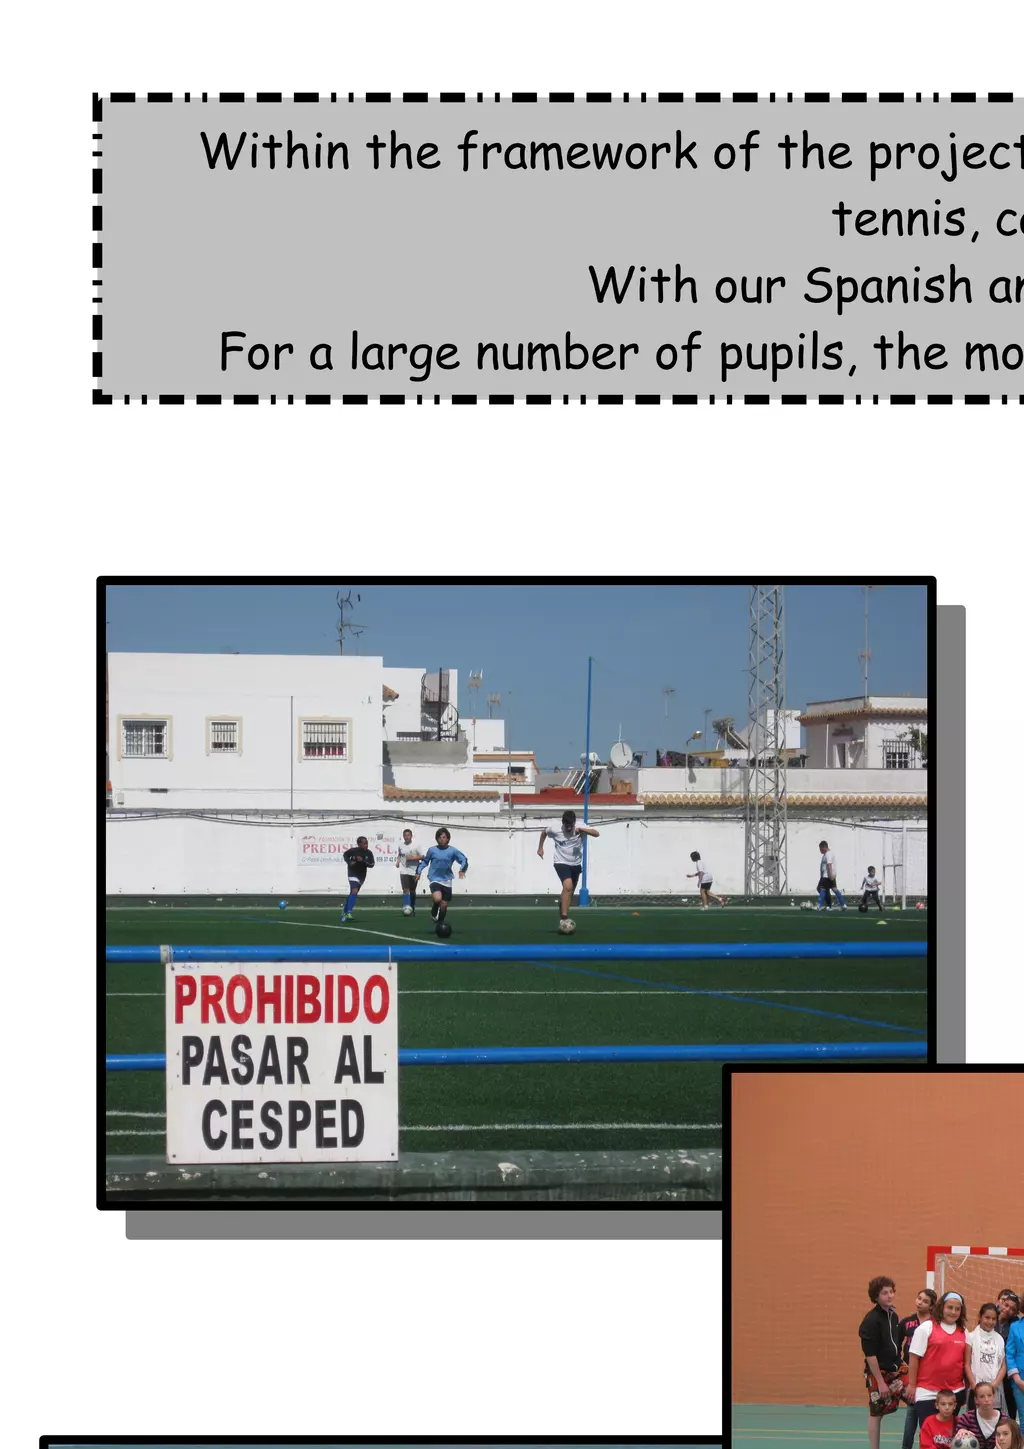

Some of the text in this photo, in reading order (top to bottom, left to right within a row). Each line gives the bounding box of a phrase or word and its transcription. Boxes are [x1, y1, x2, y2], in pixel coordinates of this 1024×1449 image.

[303, 843, 353, 854] PREDIS
[175, 974, 390, 1024] PROHIBIDO
[182, 1034, 384, 1085] PASAR AL
[202, 1099, 365, 1150] CESPED
